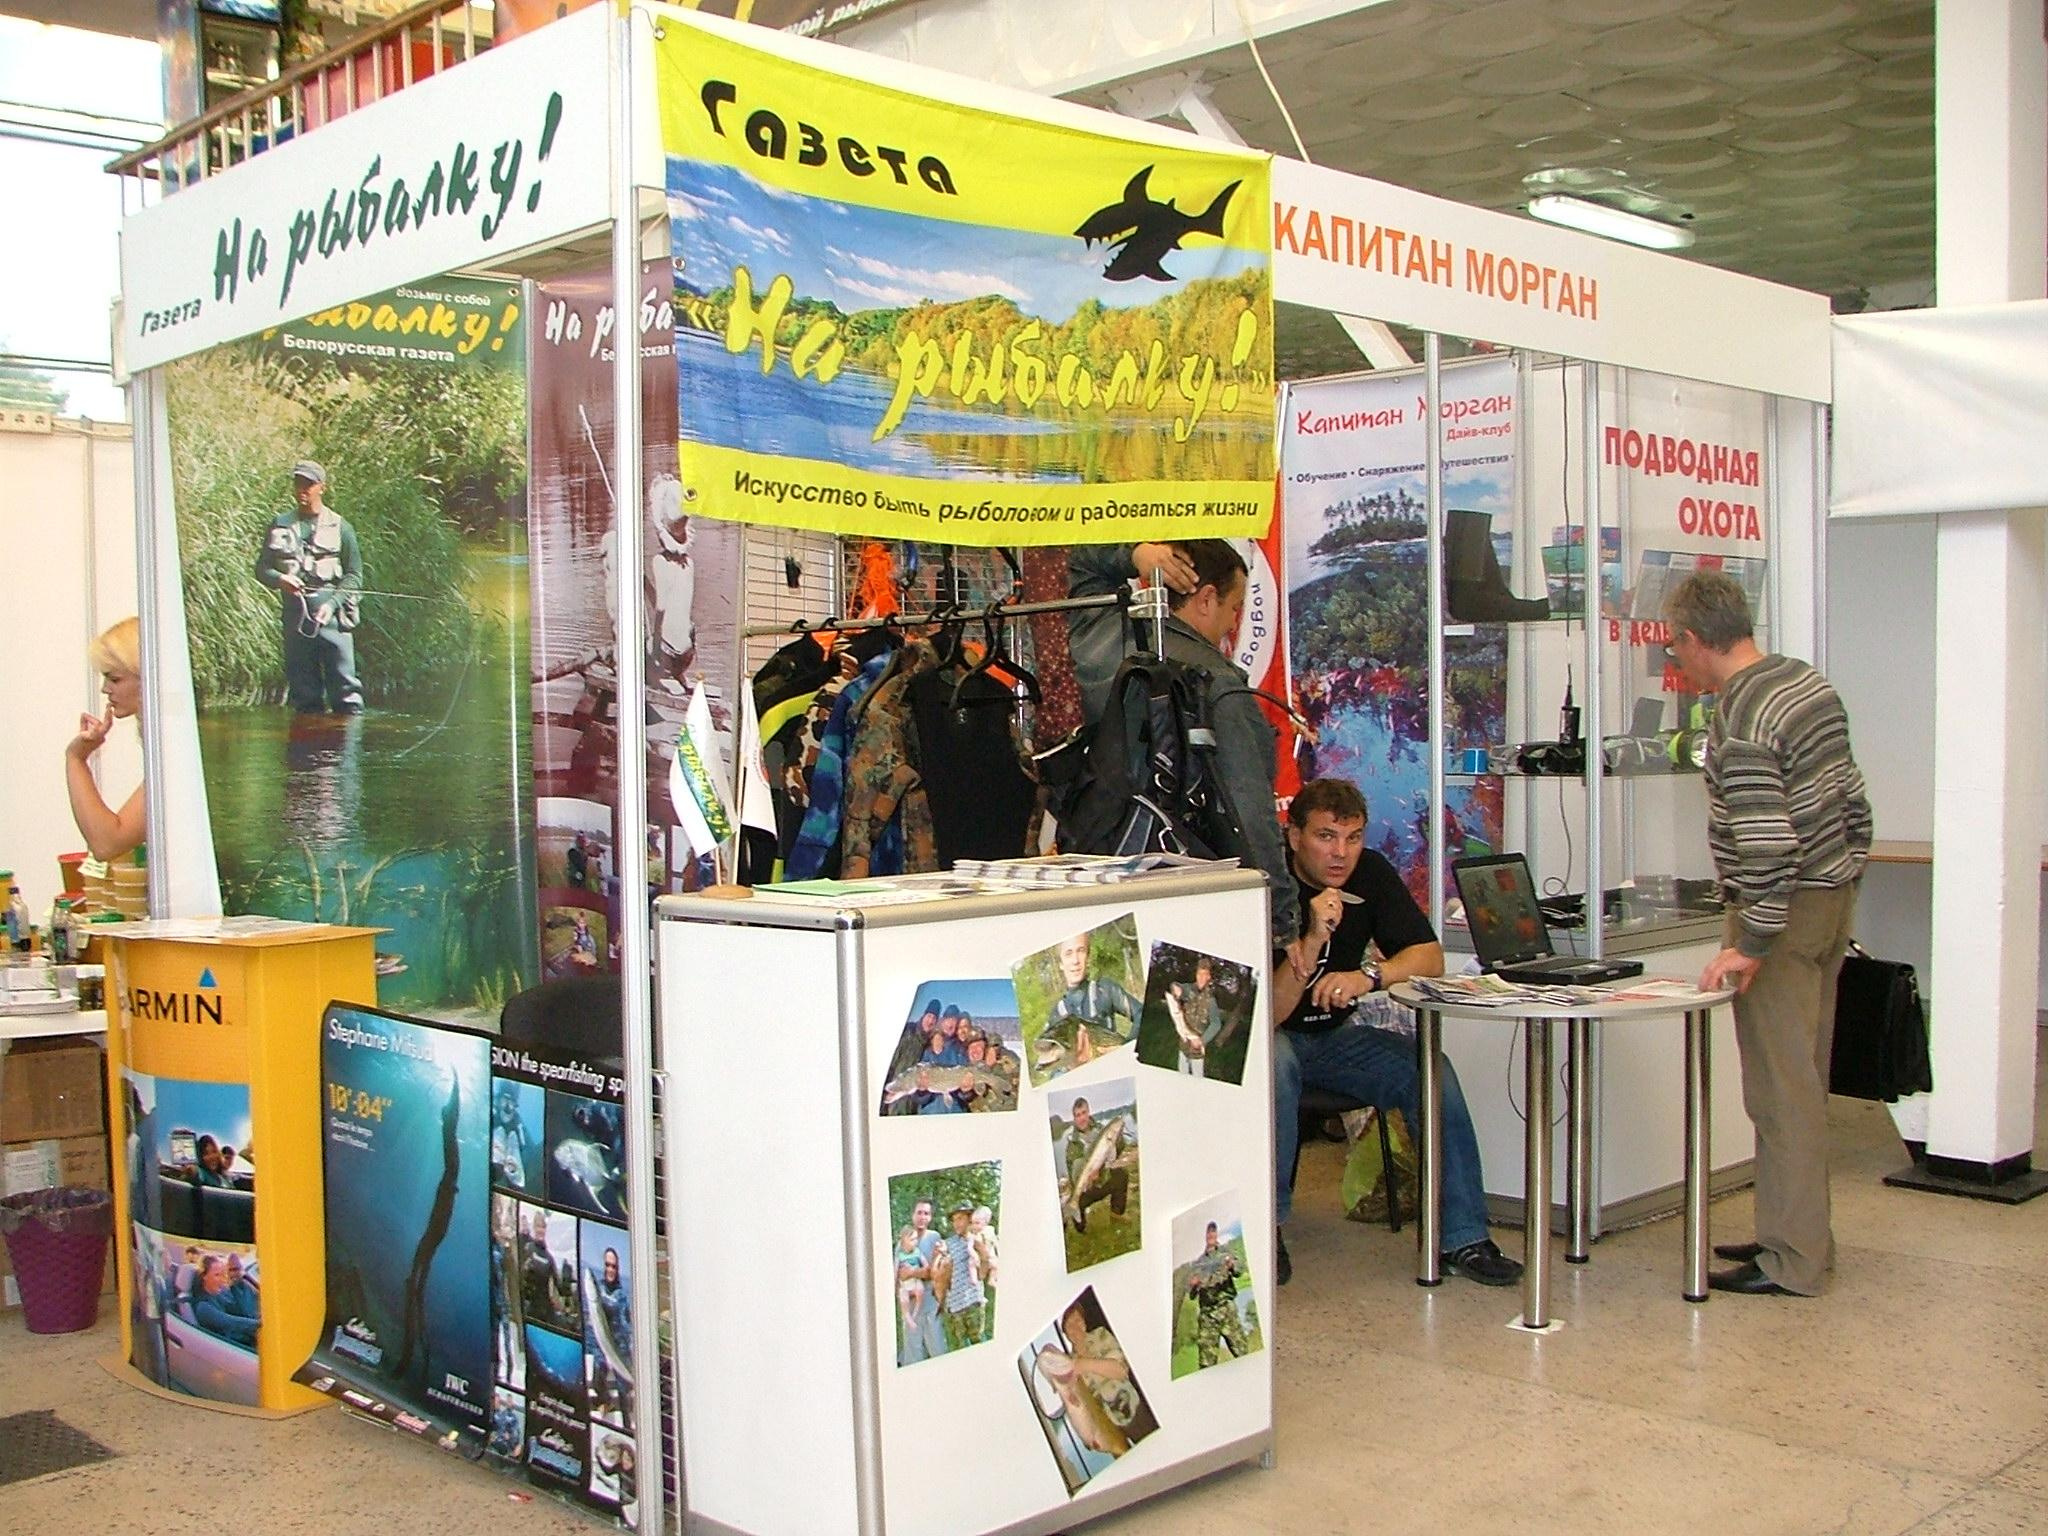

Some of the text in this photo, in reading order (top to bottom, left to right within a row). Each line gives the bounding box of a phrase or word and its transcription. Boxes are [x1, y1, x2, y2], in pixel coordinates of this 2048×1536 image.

[700, 80, 959, 196] Газета
[140, 91, 563, 337] Газета На рыбалку!
[1274, 202, 1597, 320] КАПИТАН МОРГАН
[444, 293, 453, 302] с
[454, 293, 491, 306] собой
[545, 300, 582, 346] На
[283, 333, 455, 363] Белорусская газета
[1297, 409, 1403, 435] Капитан
[1446, 423, 1512, 442] Дайв-клуб
[1296, 471, 1347, 484] Обучение
[1358, 463, 1426, 479] Снаряжение
[1605, 427, 1760, 487] ПОДВОДНАЯ
[734, 469, 1259, 526] Искусство быть рыболовом и радоваться жизни
[1678, 497, 1761, 541] ОХОТА
[1241, 584, 1267, 666] подвод
[126, 988, 222, 1025] ARMIN
[329, 1018, 388, 1050] Stephane
[492, 1046, 624, 1096] SION the spearfishing sp
